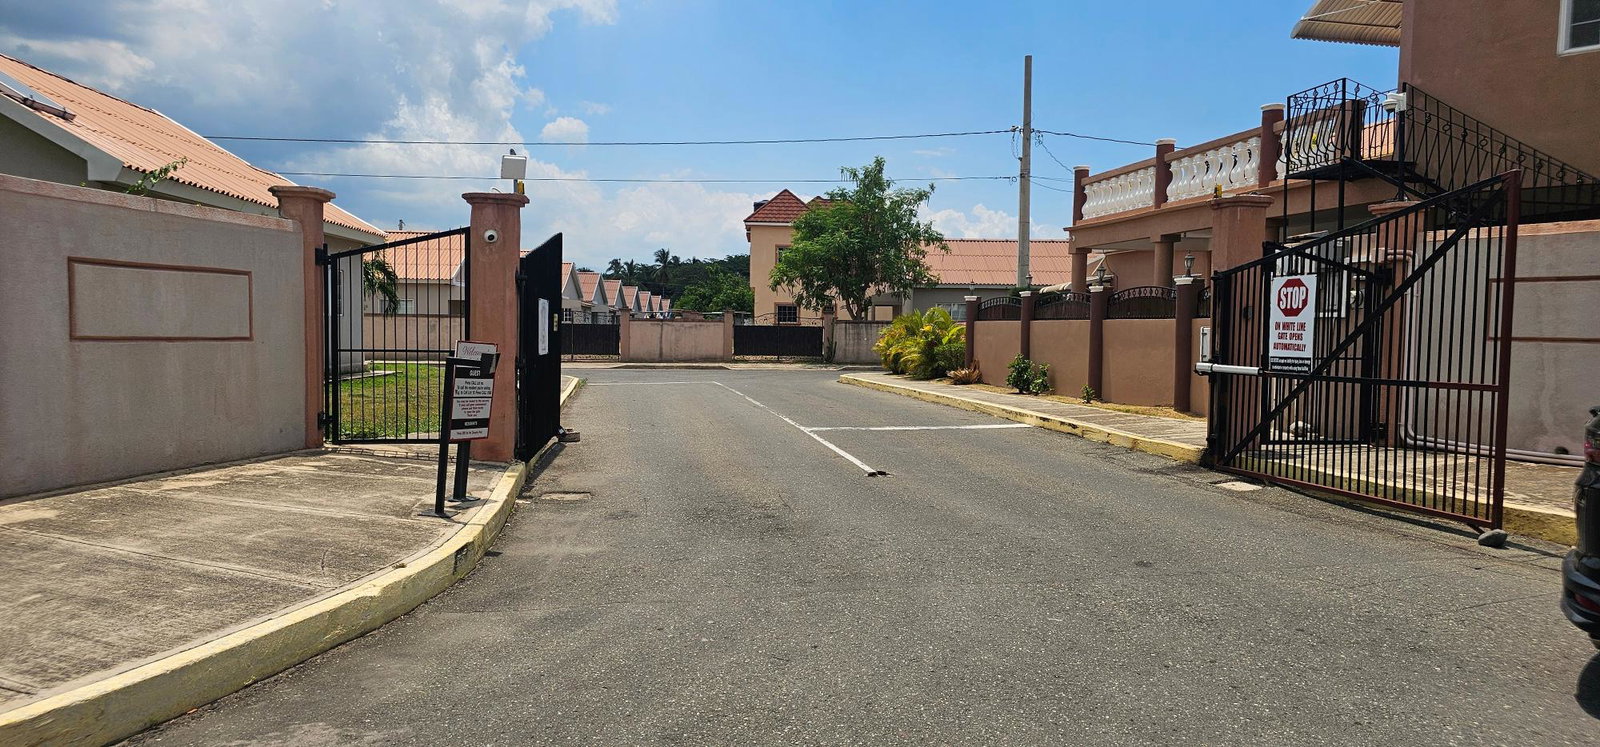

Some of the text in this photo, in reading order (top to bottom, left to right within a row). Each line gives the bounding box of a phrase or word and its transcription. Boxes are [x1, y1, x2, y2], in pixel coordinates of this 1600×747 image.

[1280, 286, 1306, 309] STOP
[1274, 321, 1306, 332] ON WHITE LINE
[1278, 332, 1304, 341] GATE OPENS
[1273, 342, 1306, 352] AUTOMATICALLY
